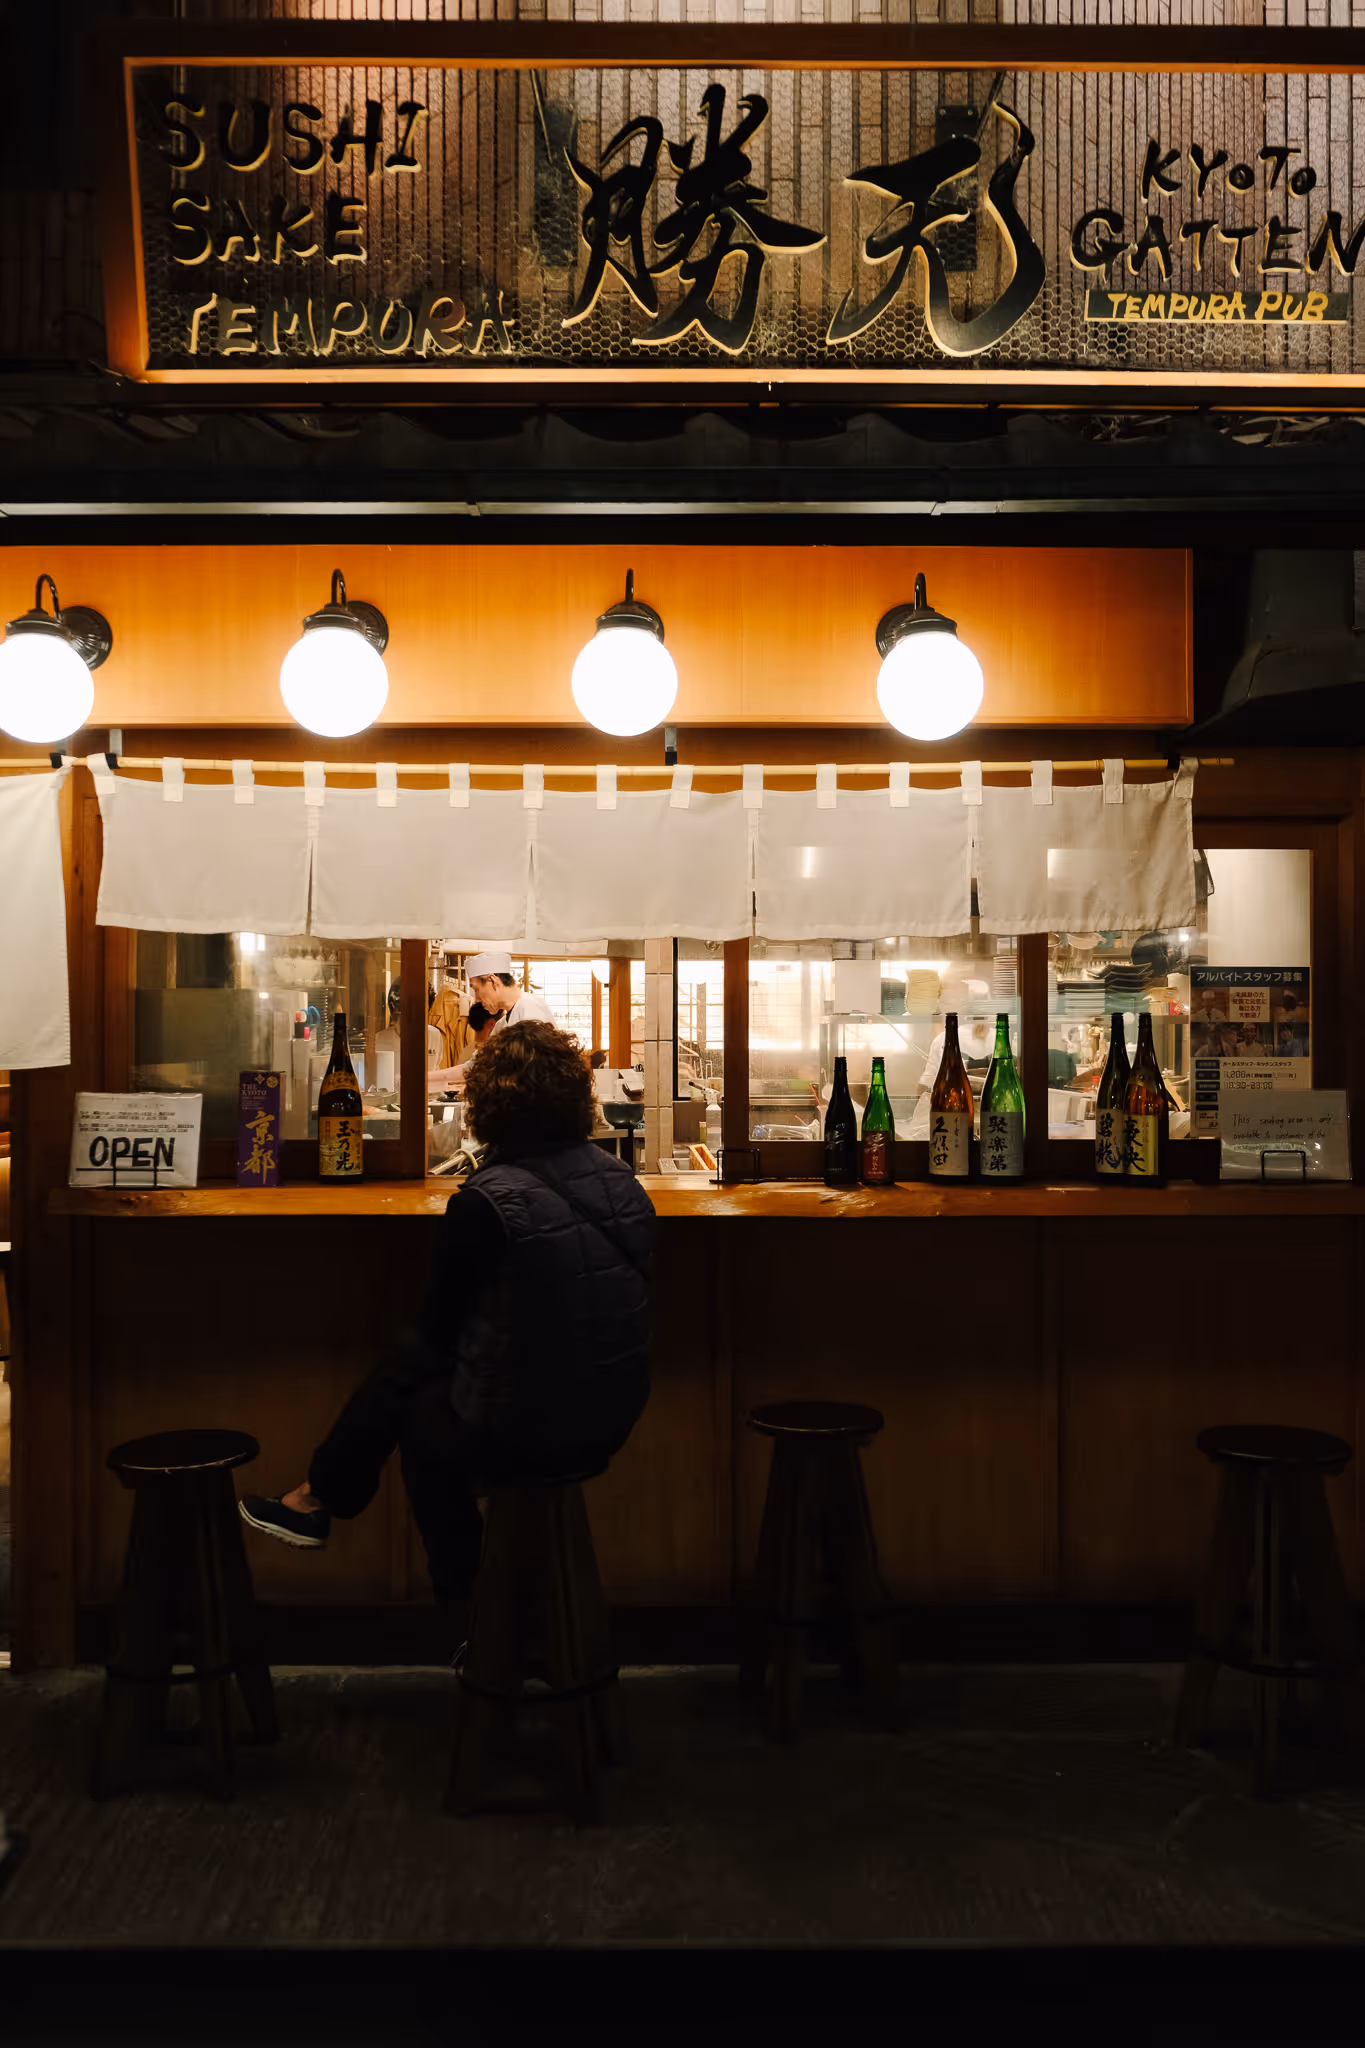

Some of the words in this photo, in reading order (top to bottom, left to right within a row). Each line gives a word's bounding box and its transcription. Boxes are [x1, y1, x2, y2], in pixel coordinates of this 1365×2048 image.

[162, 98, 429, 177] SUSHI
[169, 190, 369, 267] SAKE
[1069, 206, 1365, 284] GATTEN
[183, 290, 518, 358] TEMPURA
[1106, 291, 1248, 321] TEMPURA
[1253, 290, 1330, 321] PUB
[1196, 971, 1303, 983] アルバイトスタッフ募集
[931, 1115, 949, 1167] 久保田
[1232, 1113, 1250, 1126] This
[88, 1135, 176, 1168] OPEN
[241, 1110, 275, 1185] 京都
[336, 1120, 355, 1172] 玉乃光
